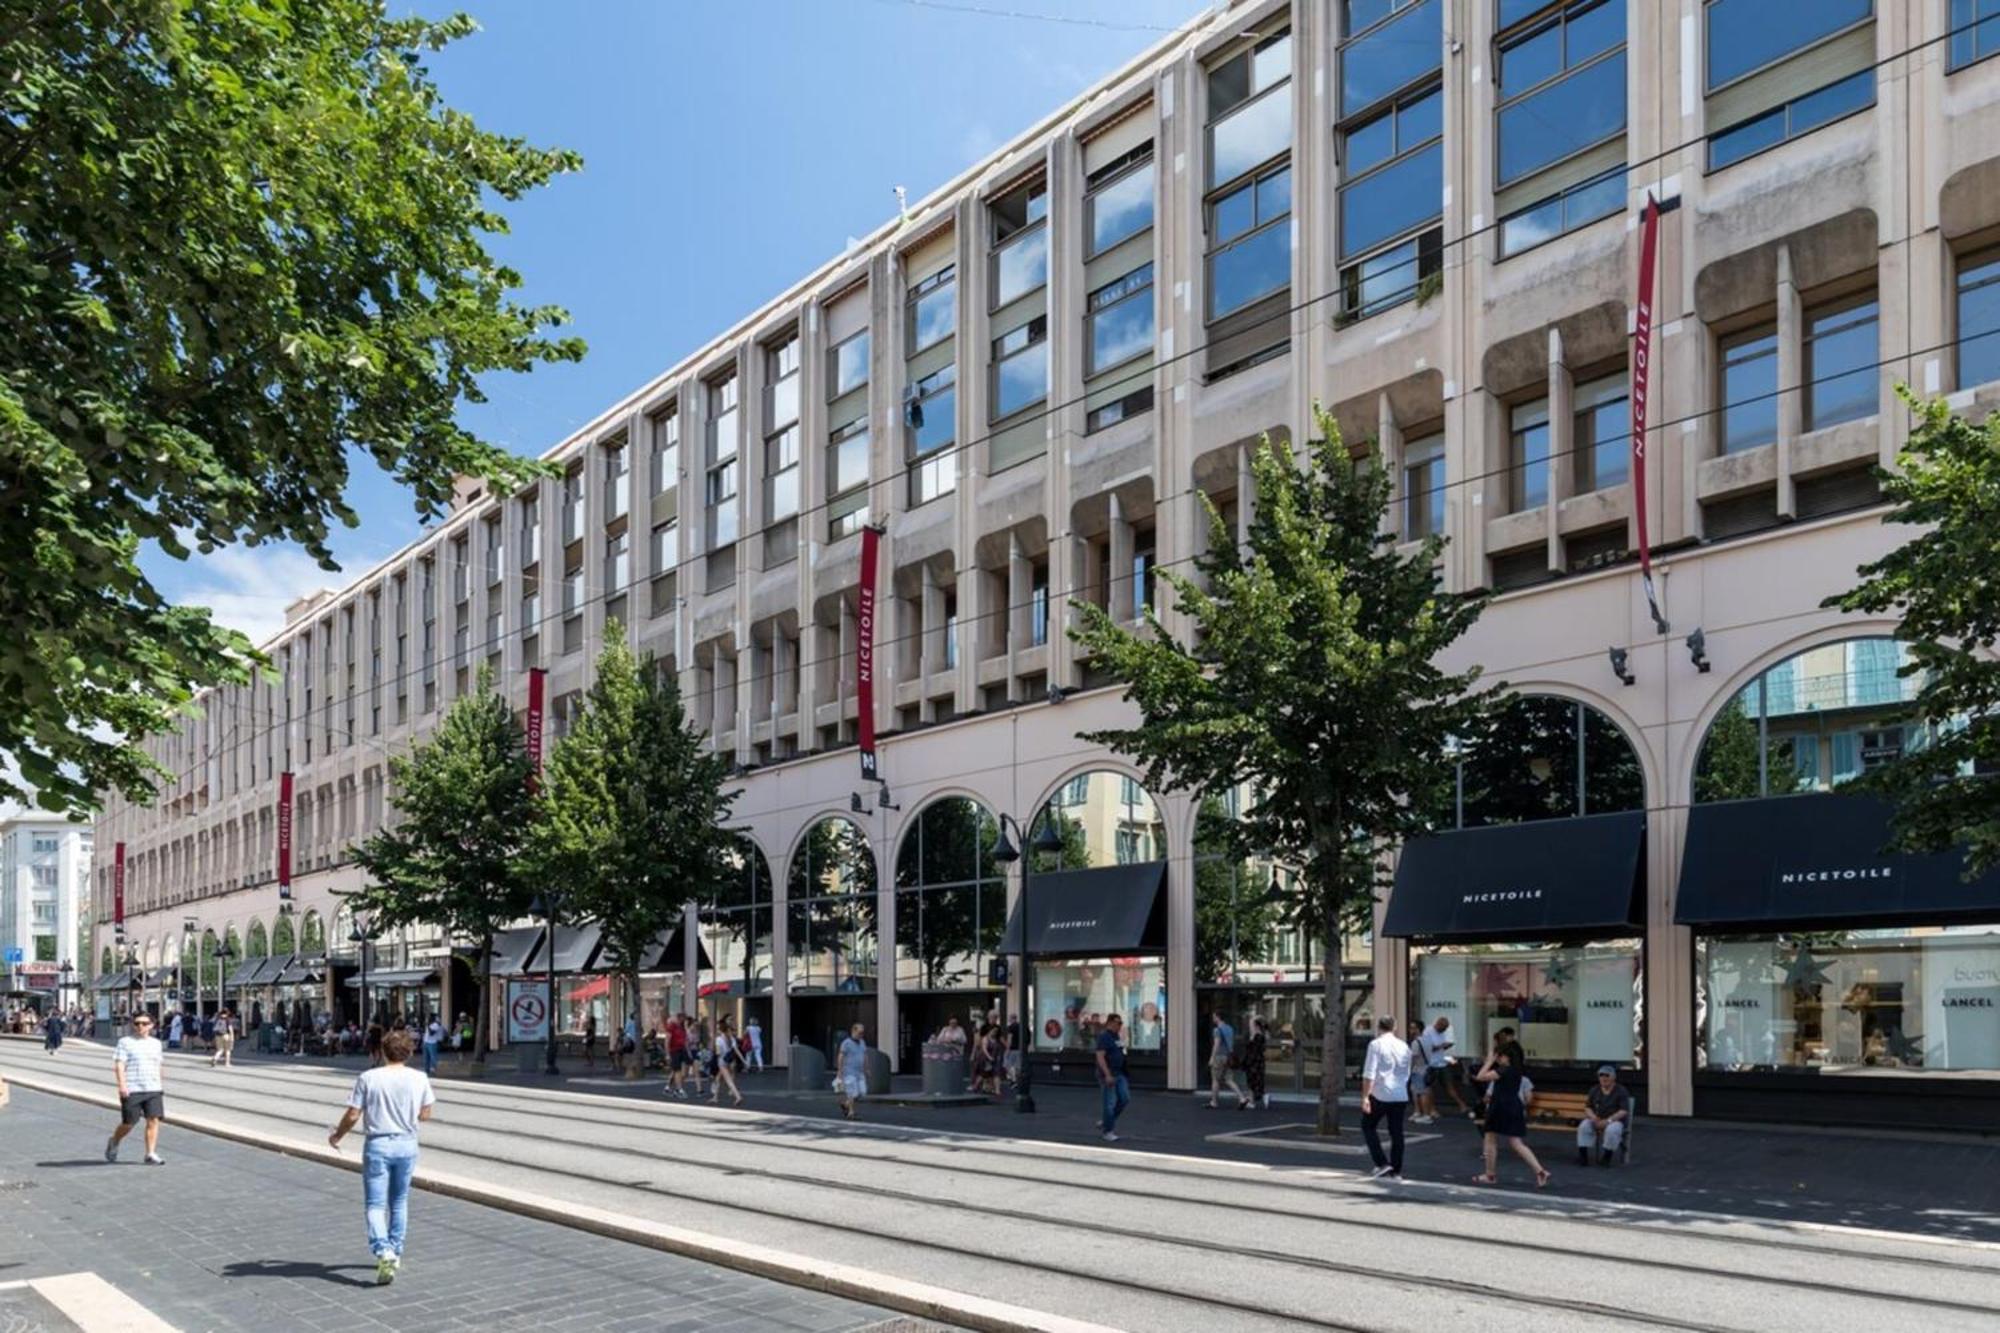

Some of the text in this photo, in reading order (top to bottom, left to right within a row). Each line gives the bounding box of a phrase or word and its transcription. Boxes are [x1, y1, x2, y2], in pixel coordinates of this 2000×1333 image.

[1635, 302, 1649, 458] NICETOILE
[861, 589, 872, 682] NICETOILE
[1782, 867, 1891, 882] NICETOILE
[1463, 889, 1541, 903] NICETOILE
[1426, 1001, 1458, 1009] LANCEL
[1587, 1000, 1624, 1009] LANCEL
[1718, 1000, 1760, 1009] LANCEL
[1942, 998, 1993, 1008] LANCEL
